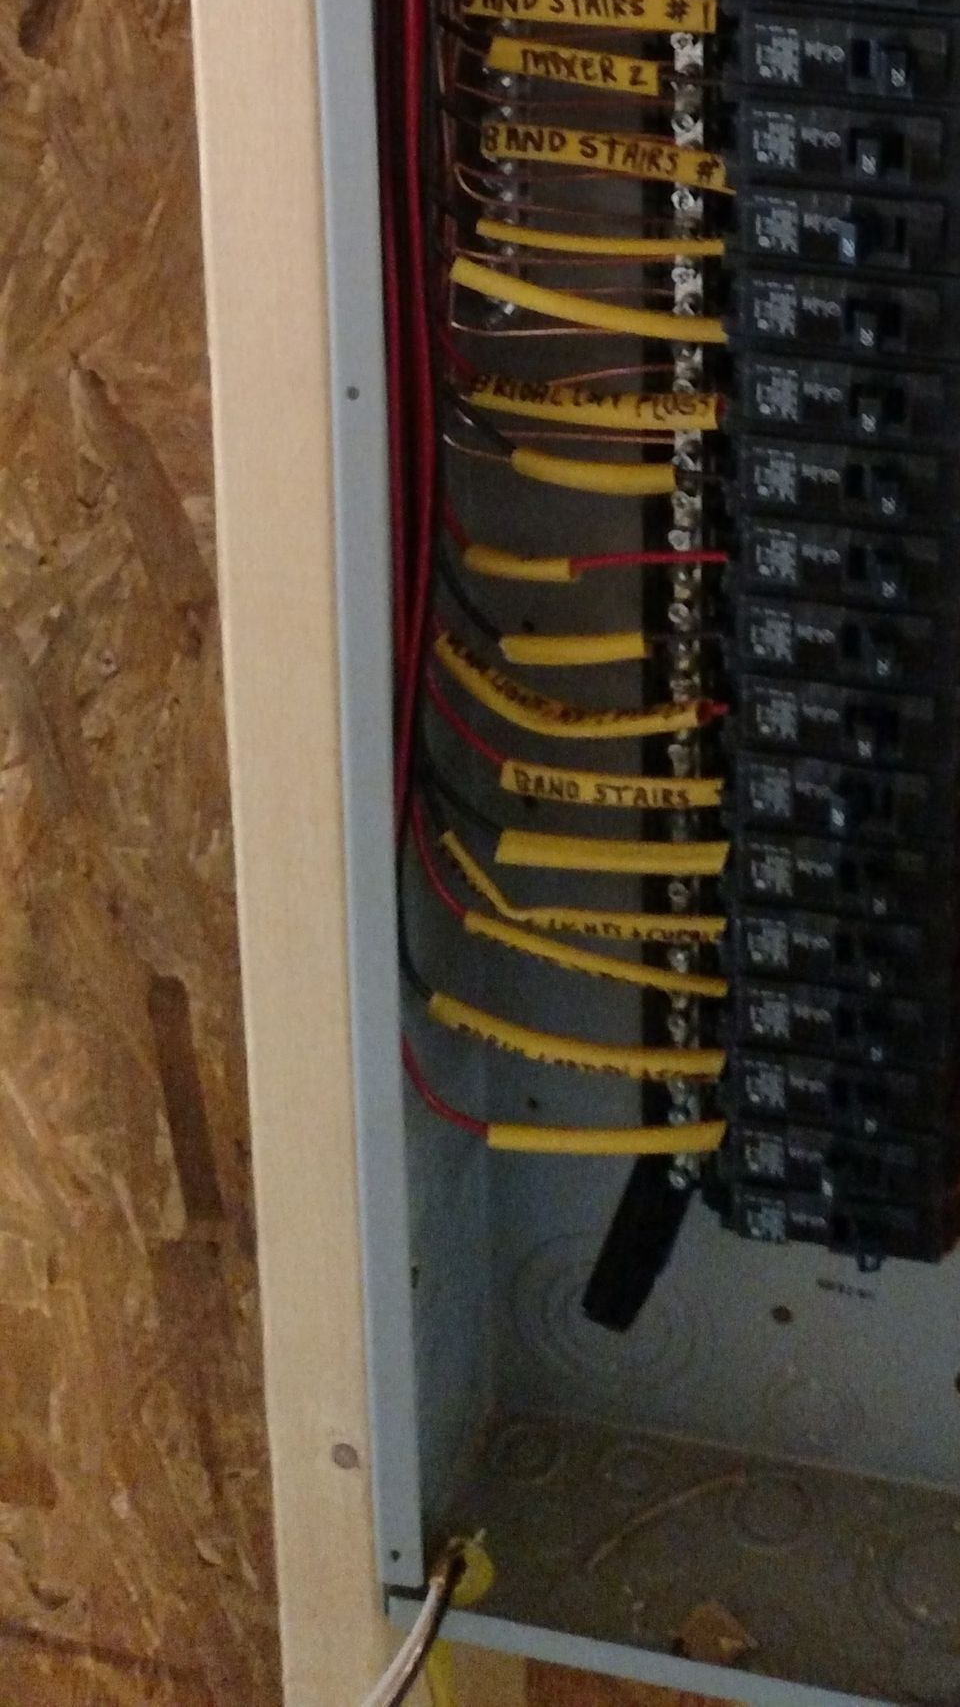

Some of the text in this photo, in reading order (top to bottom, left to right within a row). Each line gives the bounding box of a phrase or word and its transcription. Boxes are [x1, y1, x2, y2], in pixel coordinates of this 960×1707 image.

[521, 48, 618, 84] MIXER
[483, 125, 567, 155] BAND
[578, 135, 680, 175] STAIRS
[513, 767, 691, 807] BAND STAIRS
